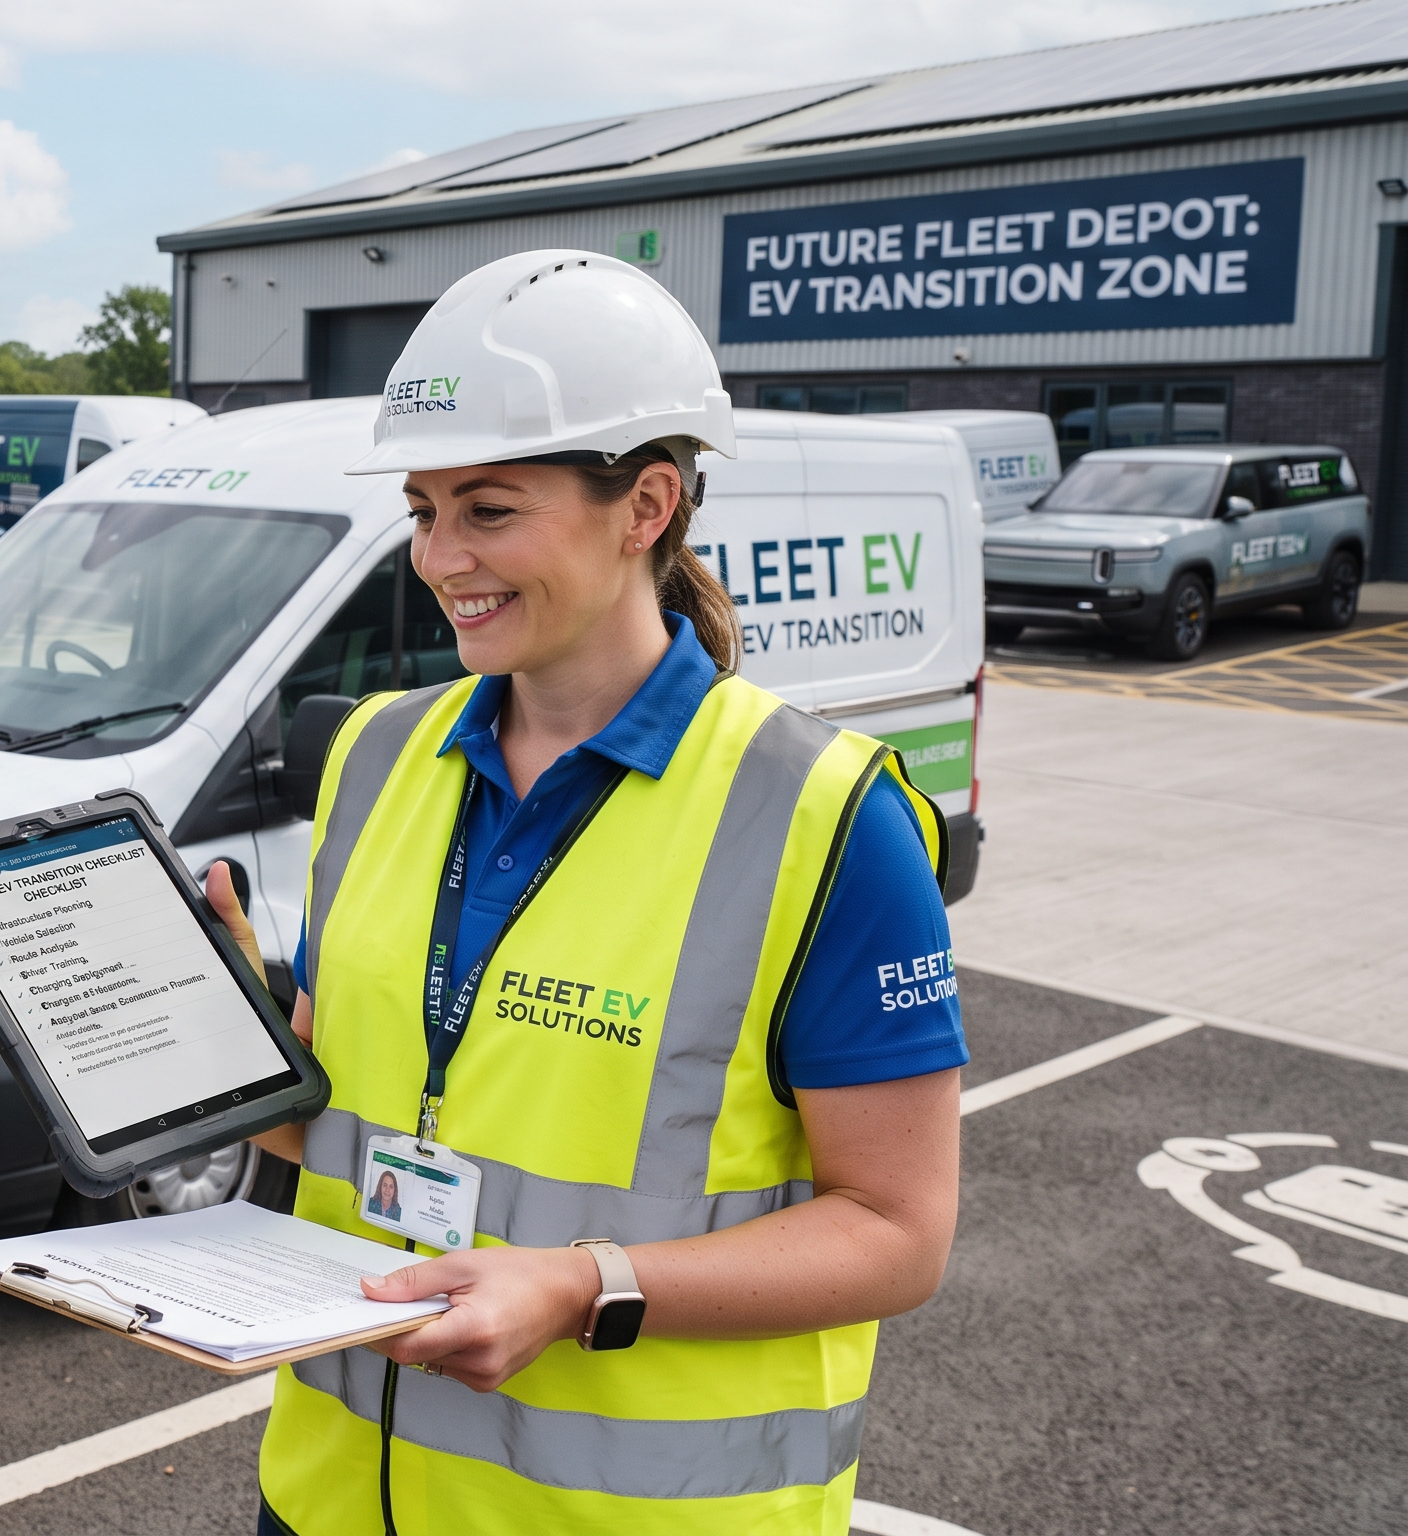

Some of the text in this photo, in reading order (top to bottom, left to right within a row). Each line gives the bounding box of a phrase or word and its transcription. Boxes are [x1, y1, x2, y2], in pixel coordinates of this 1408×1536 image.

[746, 193, 1261, 272] FUTURE FLEET DEPOT:
[748, 249, 1249, 317] EV TRANSITION ZONE
[386, 376, 461, 402] FLEET EV
[7, 436, 41, 467] EV
[979, 456, 1025, 480] FLEET
[116, 468, 212, 490] FLEET
[863, 532, 922, 595] EV
[743, 608, 924, 655] EV TRANSITION
[13, 862, 85, 889] TRANSITION
[84, 847, 146, 871] CHECKLIST
[23, 876, 88, 902] CHECKLIST
[449, 844, 465, 889] FLEET
[877, 951, 945, 988] FLEET
[445, 982, 474, 1033] FLEET
[500, 970, 651, 1021] FLEET EV
[495, 999, 643, 1047] SOLUTIONS
